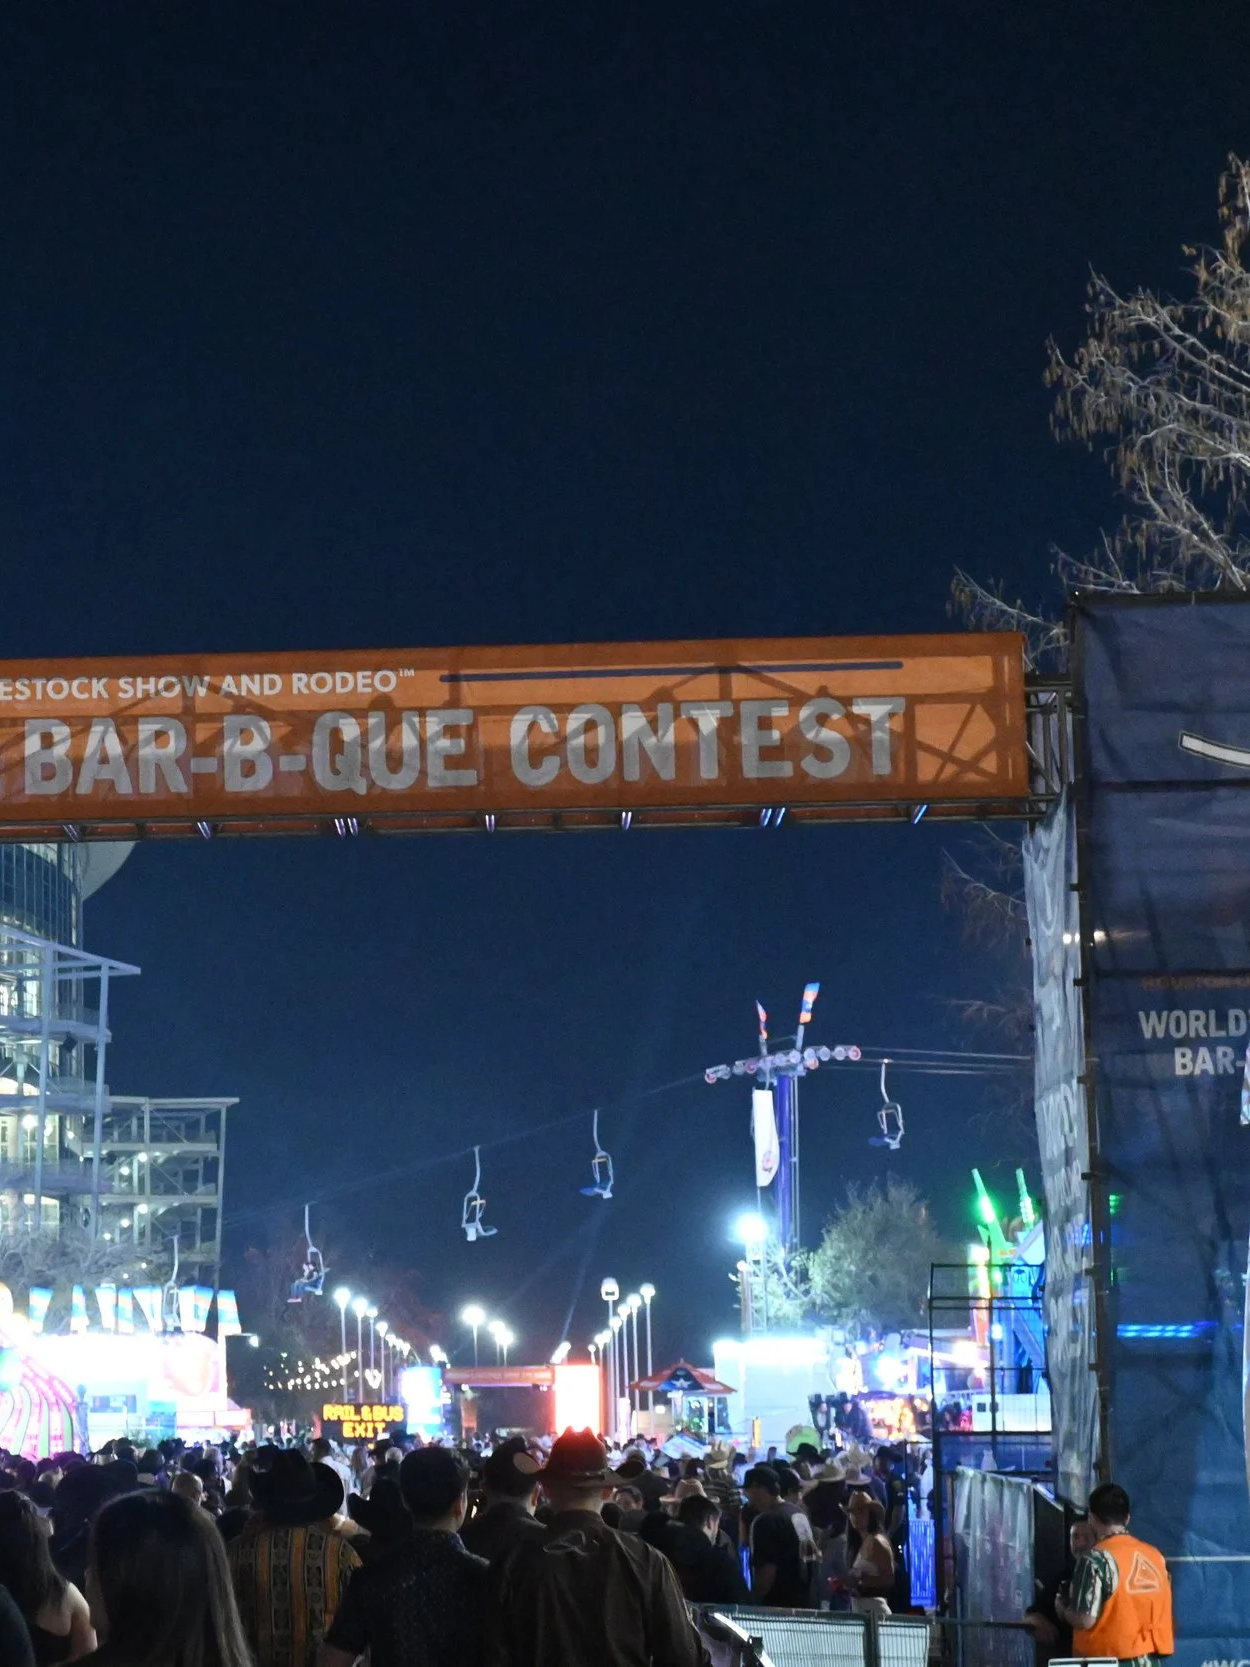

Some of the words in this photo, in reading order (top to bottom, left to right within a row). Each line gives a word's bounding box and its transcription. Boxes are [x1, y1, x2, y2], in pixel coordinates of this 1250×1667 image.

[118, 673, 211, 700] SHOW
[222, 672, 283, 696] AND
[24, 709, 478, 796] BAR-B-QUE
[510, 696, 906, 787] CONTEST
[1138, 1008, 1250, 1039] WORLD
[343, 1421, 386, 1438] EXIT
